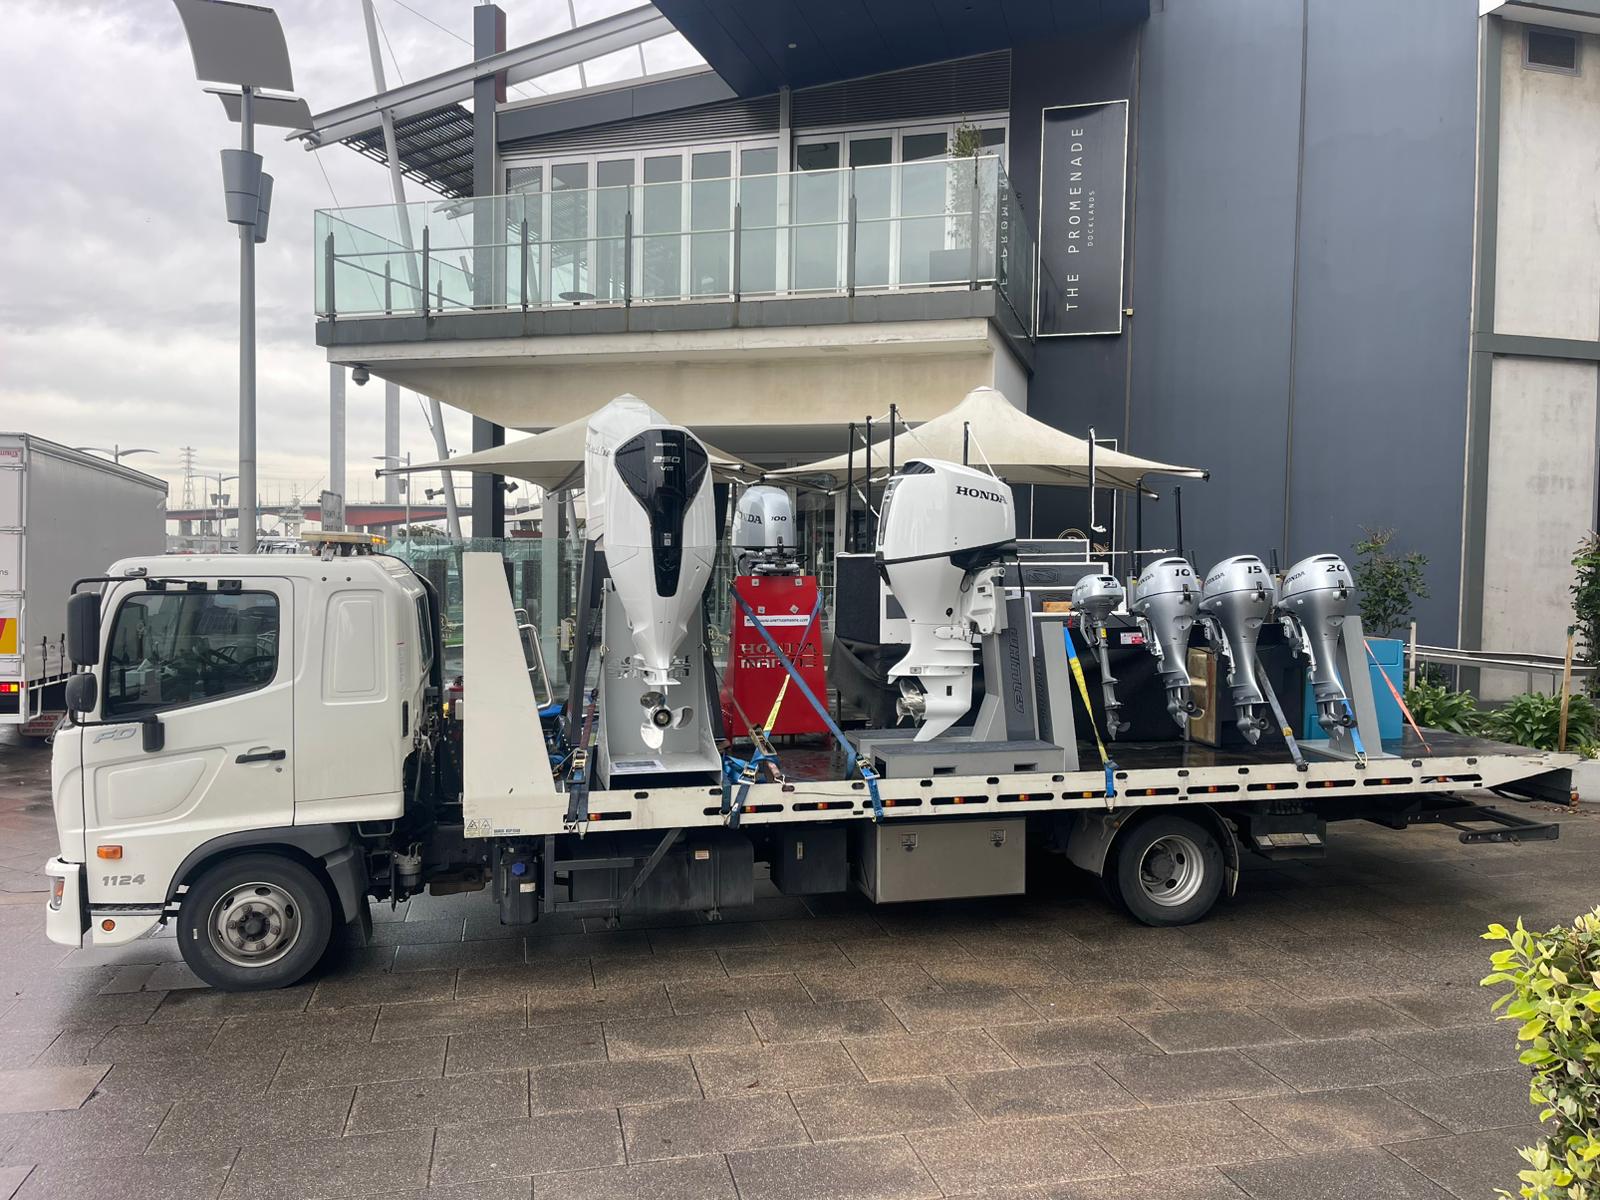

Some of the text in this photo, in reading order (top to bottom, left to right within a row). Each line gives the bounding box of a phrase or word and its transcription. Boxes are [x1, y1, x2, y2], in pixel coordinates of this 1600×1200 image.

[1066, 128, 1084, 311] THE PROMENADE
[1087, 190, 1095, 246] DOCKLANDS
[956, 485, 1008, 505] HONDA
[1174, 568, 1190, 577] 10
[1247, 565, 1263, 574] 15
[1326, 564, 1345, 572] 20
[93, 727, 137, 745] FD
[102, 874, 146, 887] 1124
